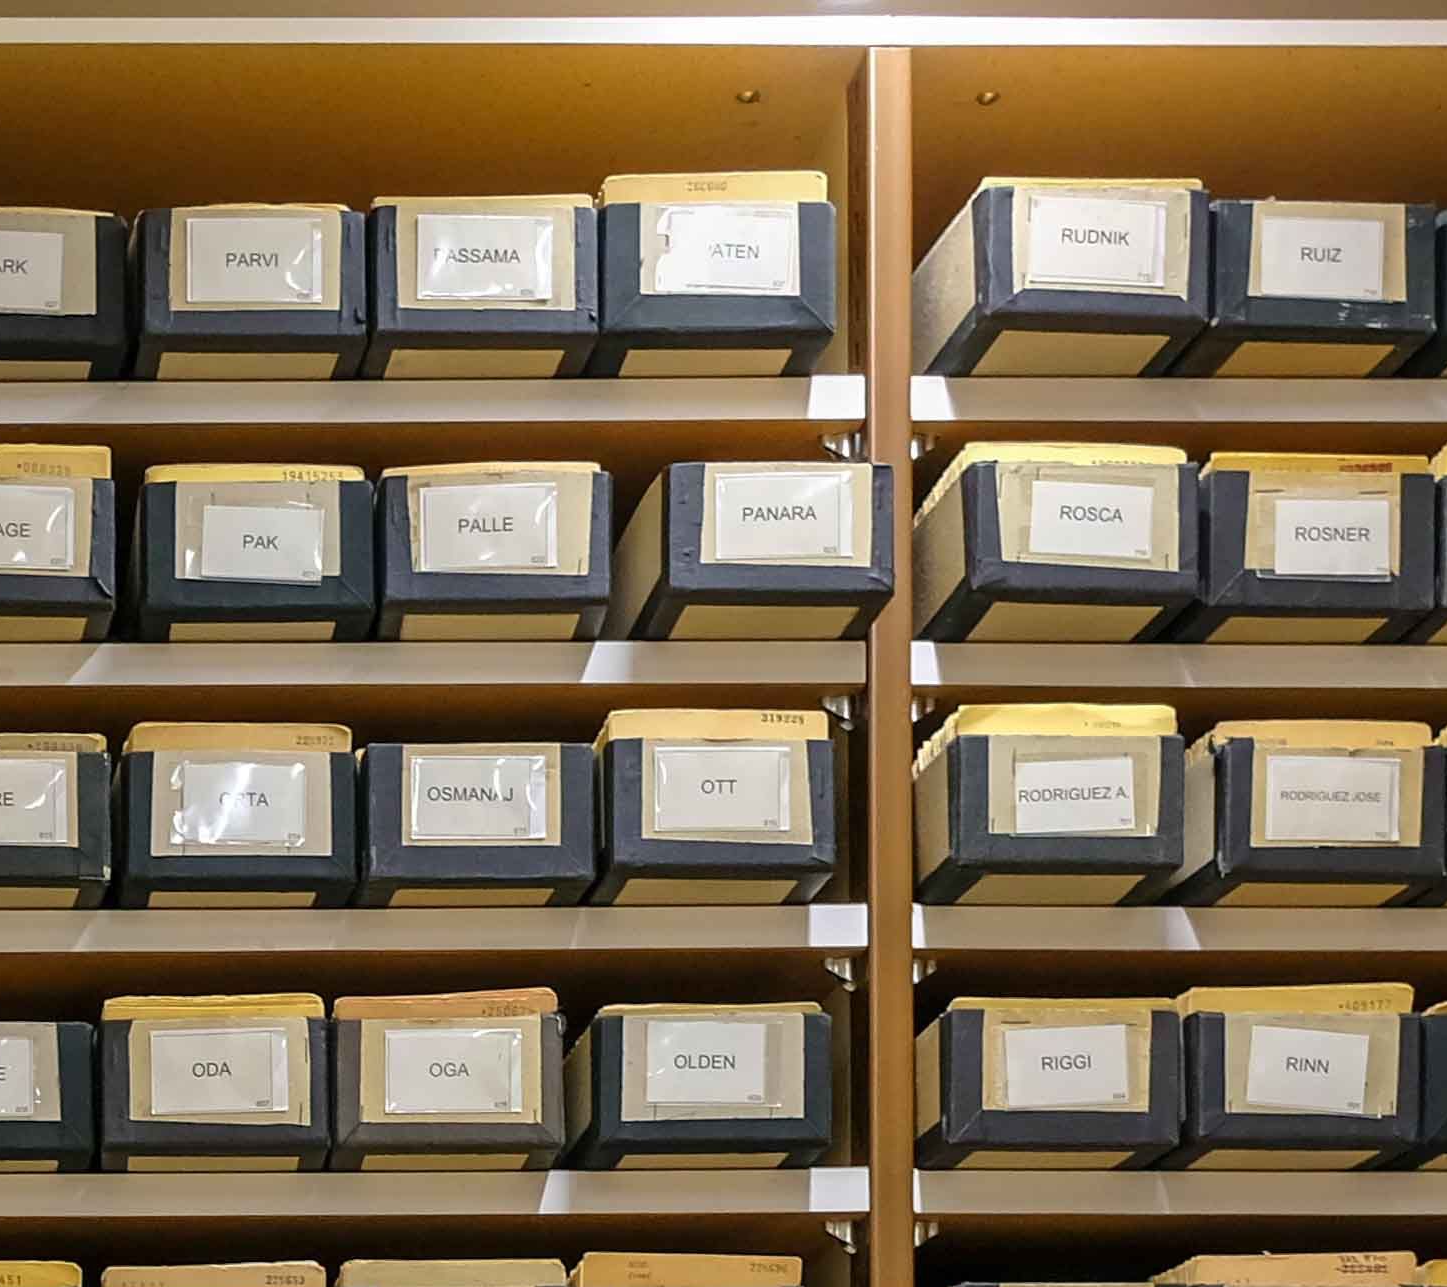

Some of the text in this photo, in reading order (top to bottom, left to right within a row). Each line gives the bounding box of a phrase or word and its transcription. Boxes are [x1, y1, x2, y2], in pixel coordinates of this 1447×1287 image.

[1061, 227, 1130, 247] RUDNIK
[225, 252, 279, 268] PARVI
[242, 534, 279, 551] PAK
[1294, 526, 1370, 542] ROSNER
[700, 778, 738, 795] OTT
[191, 1061, 232, 1079] ODA
[1041, 1054, 1092, 1071] RIGGI
